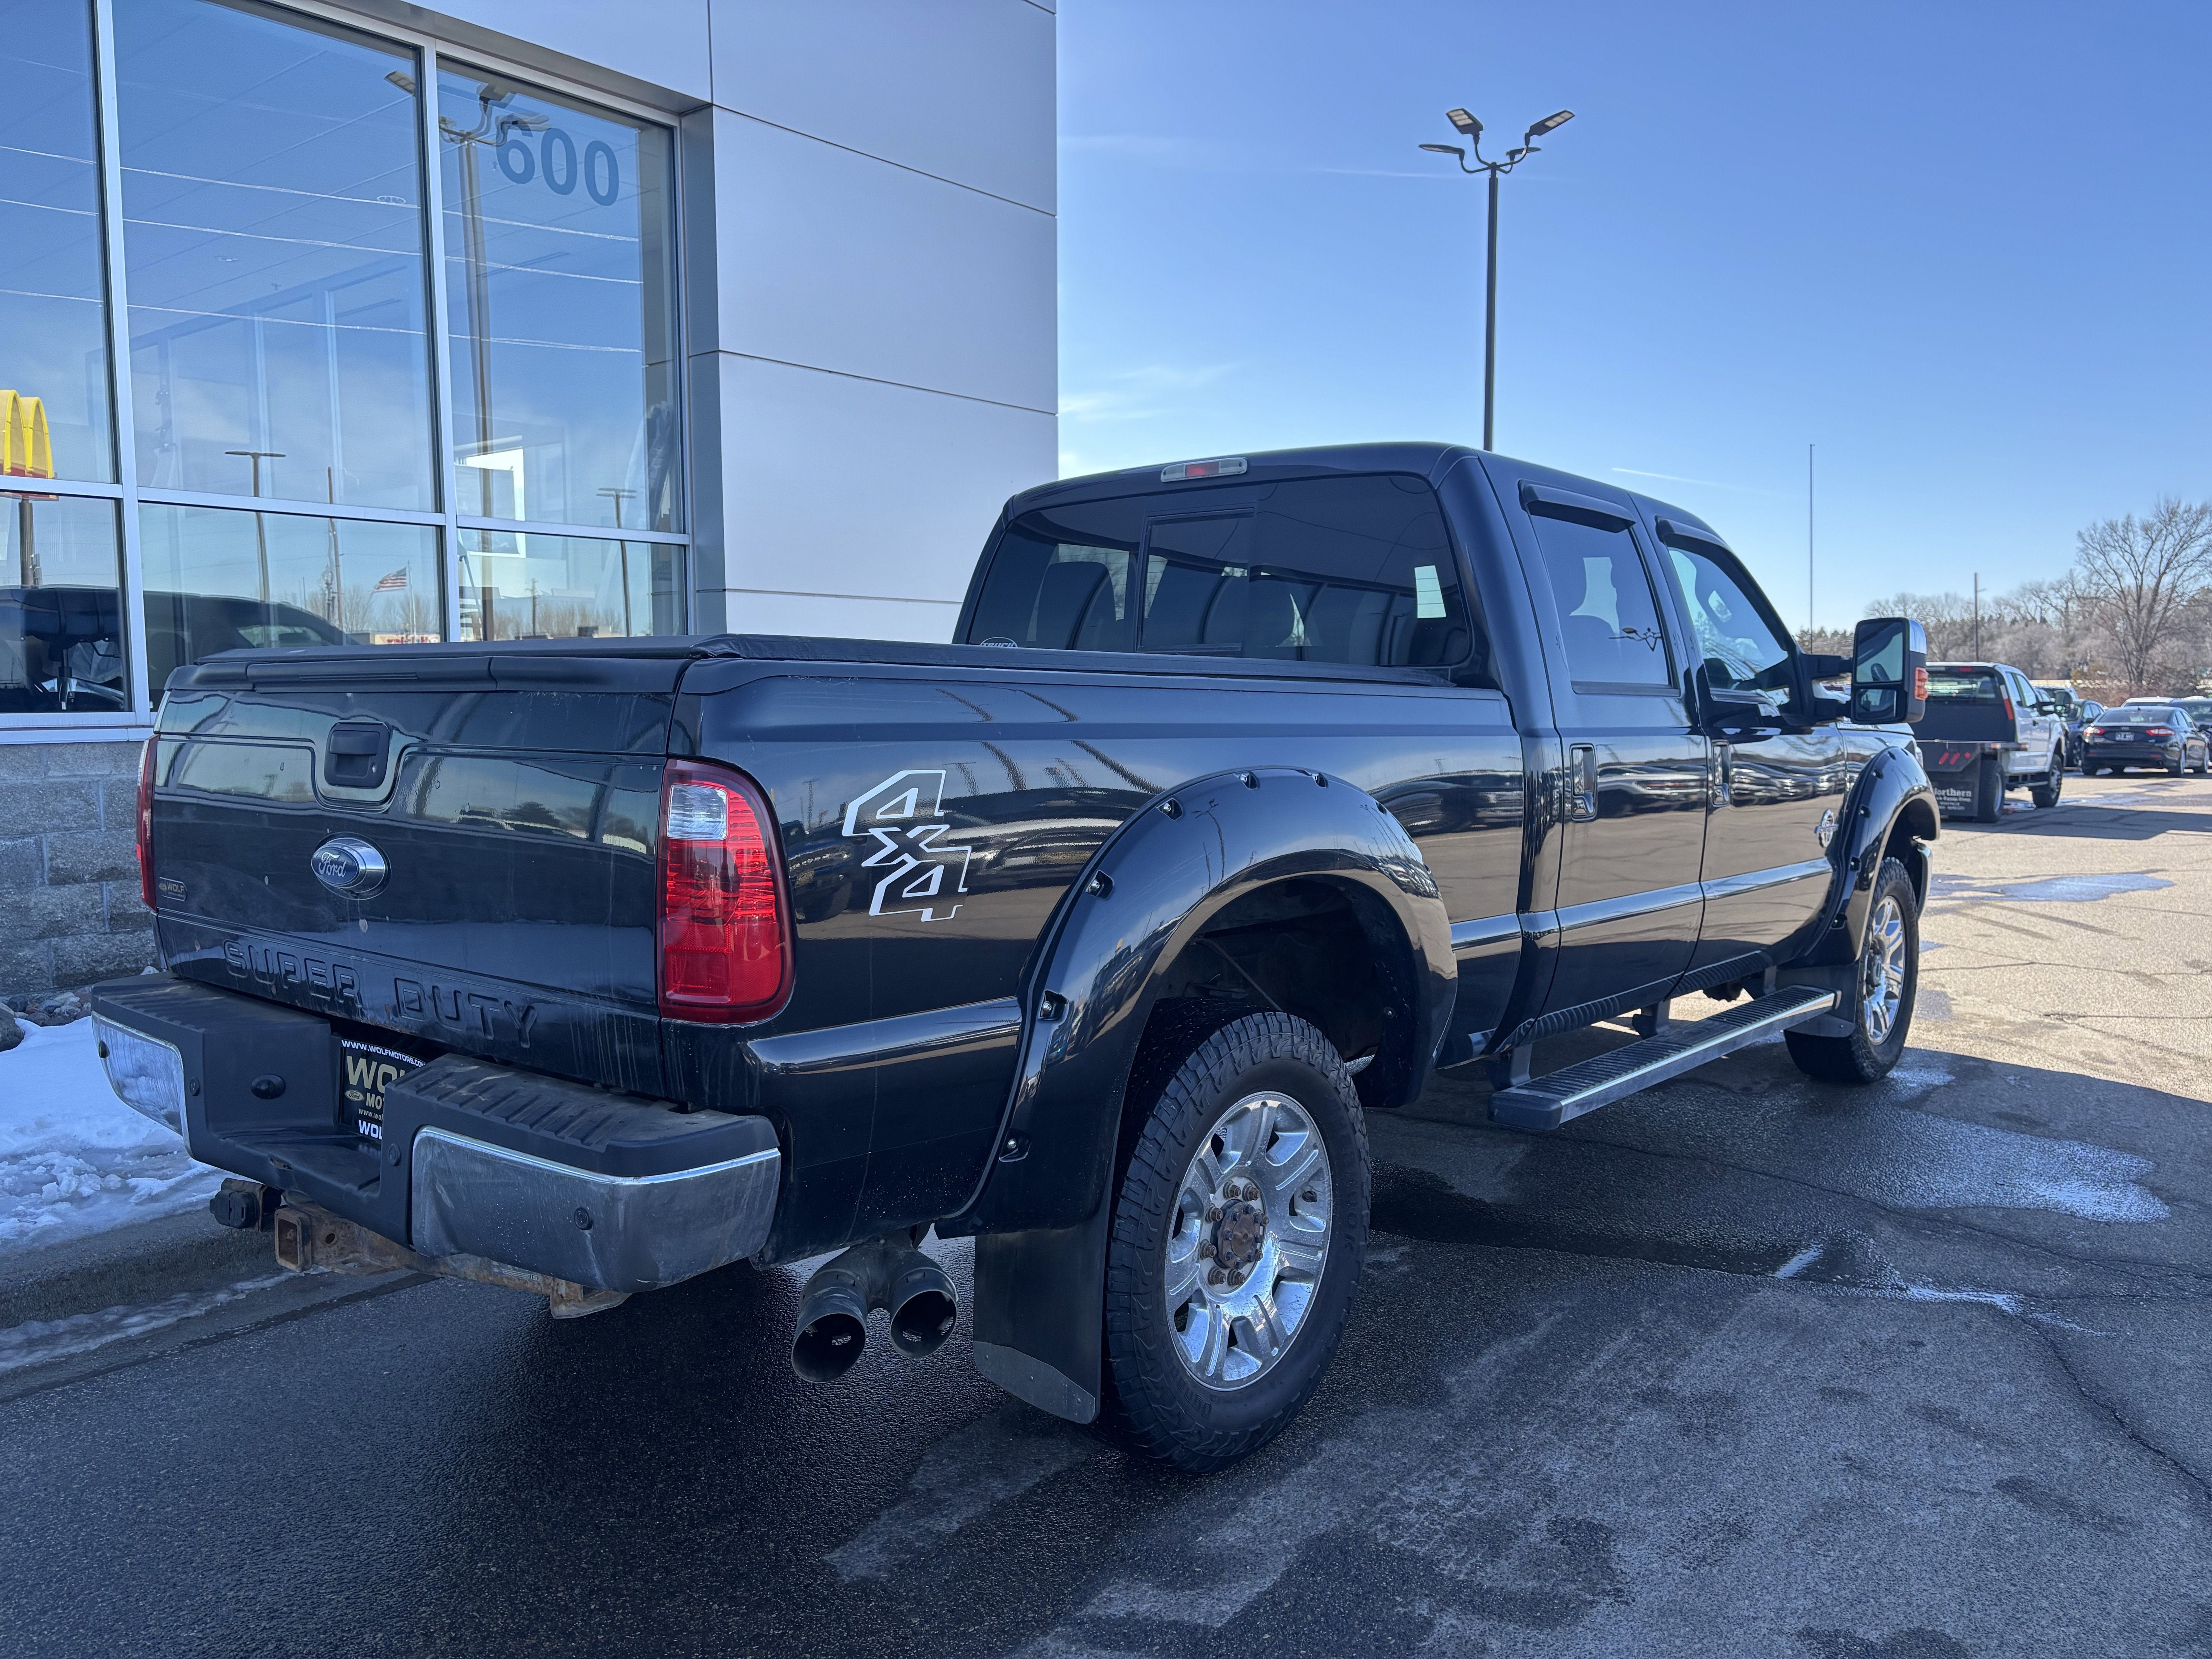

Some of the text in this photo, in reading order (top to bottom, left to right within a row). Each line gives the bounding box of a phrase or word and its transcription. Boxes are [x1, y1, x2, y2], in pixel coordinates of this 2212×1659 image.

[496, 114, 619, 206] 600
[318, 852, 347, 878] Ford
[167, 882, 185, 893] WOLF
[223, 939, 538, 1049] SUPER DUTY
[347, 1055, 405, 1094] WO
[366, 1092, 385, 1110] MO
